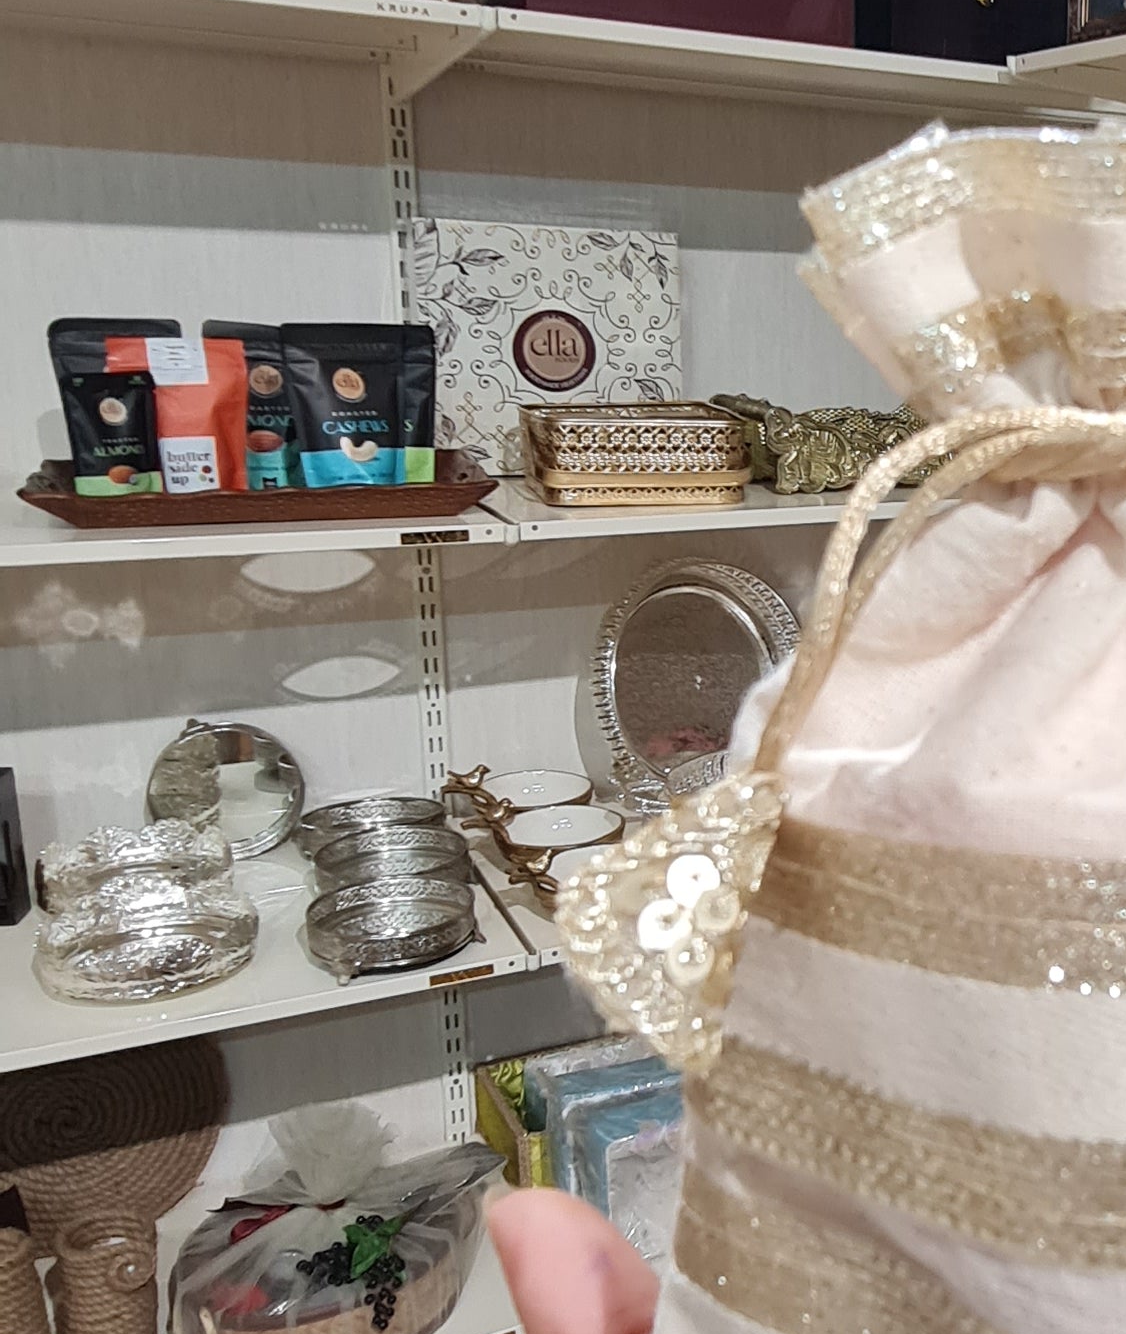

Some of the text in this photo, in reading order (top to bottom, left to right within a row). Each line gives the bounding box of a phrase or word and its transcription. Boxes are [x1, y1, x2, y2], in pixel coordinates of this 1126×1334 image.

[376, 1, 430, 17] KRUPA
[530, 329, 579, 357] ella
[166, 451, 211, 463] butter
[171, 476, 190, 487] up
